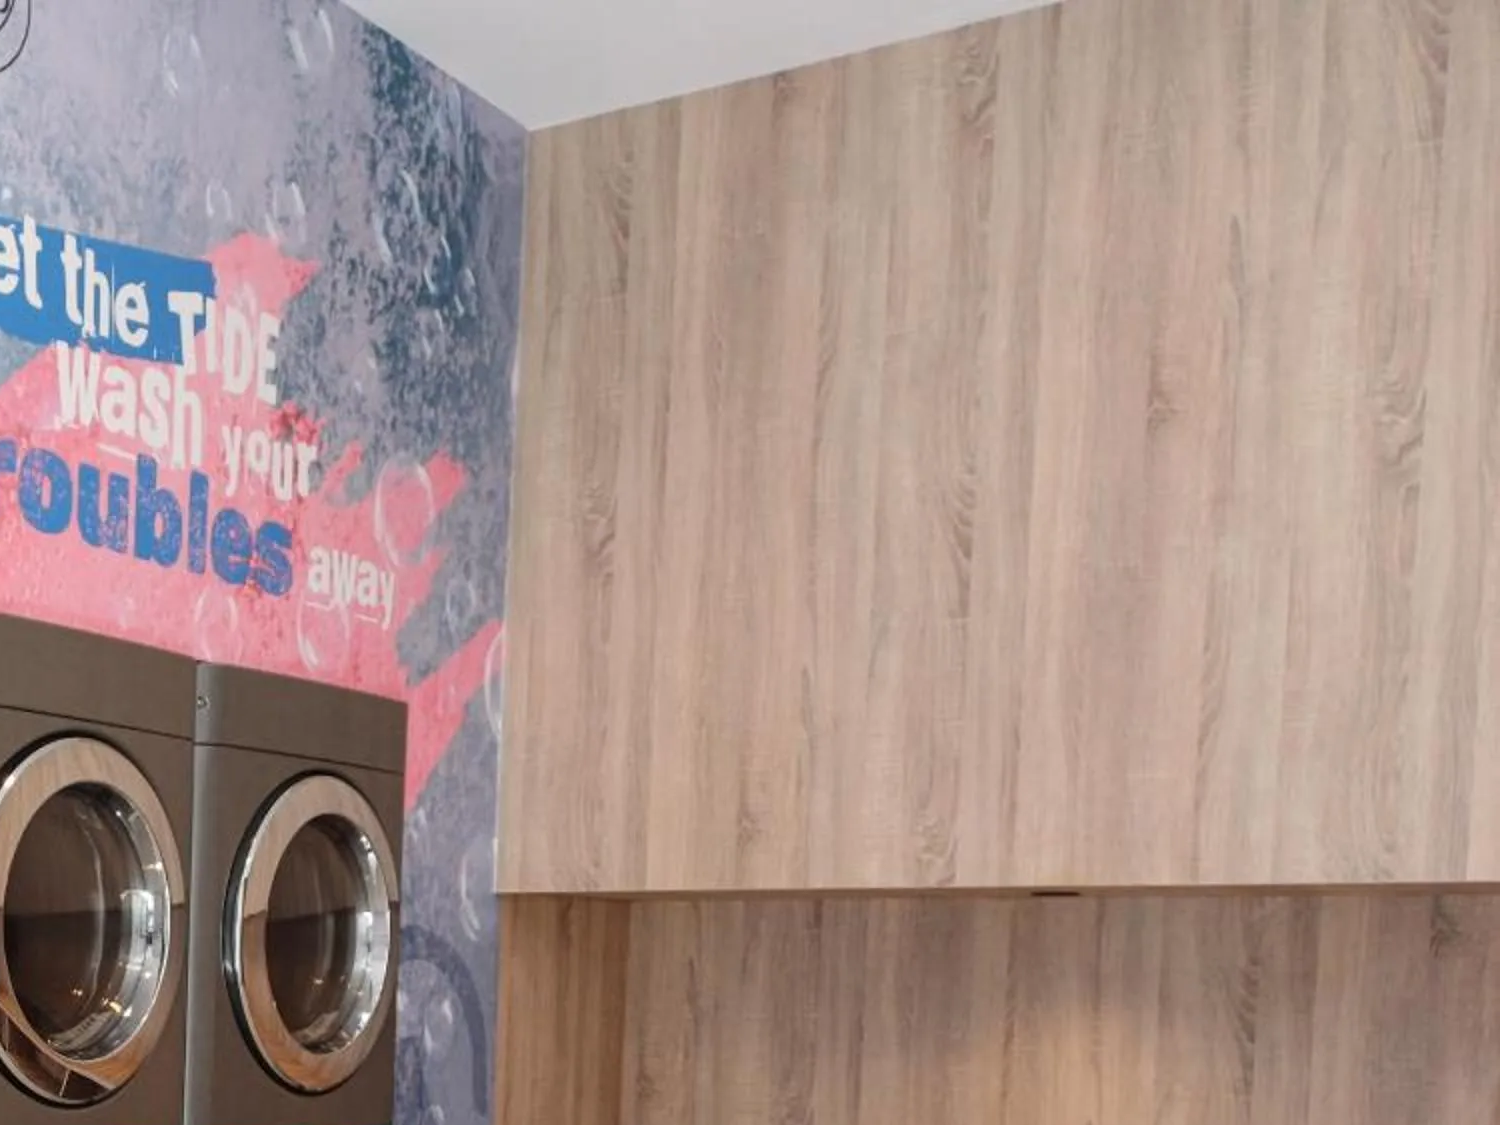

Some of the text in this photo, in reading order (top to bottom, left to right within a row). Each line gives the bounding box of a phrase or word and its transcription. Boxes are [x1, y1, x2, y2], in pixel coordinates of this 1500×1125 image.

[60, 233, 150, 347] the
[168, 291, 280, 405] TIDE
[221, 422, 320, 500] your
[307, 545, 397, 628] away
